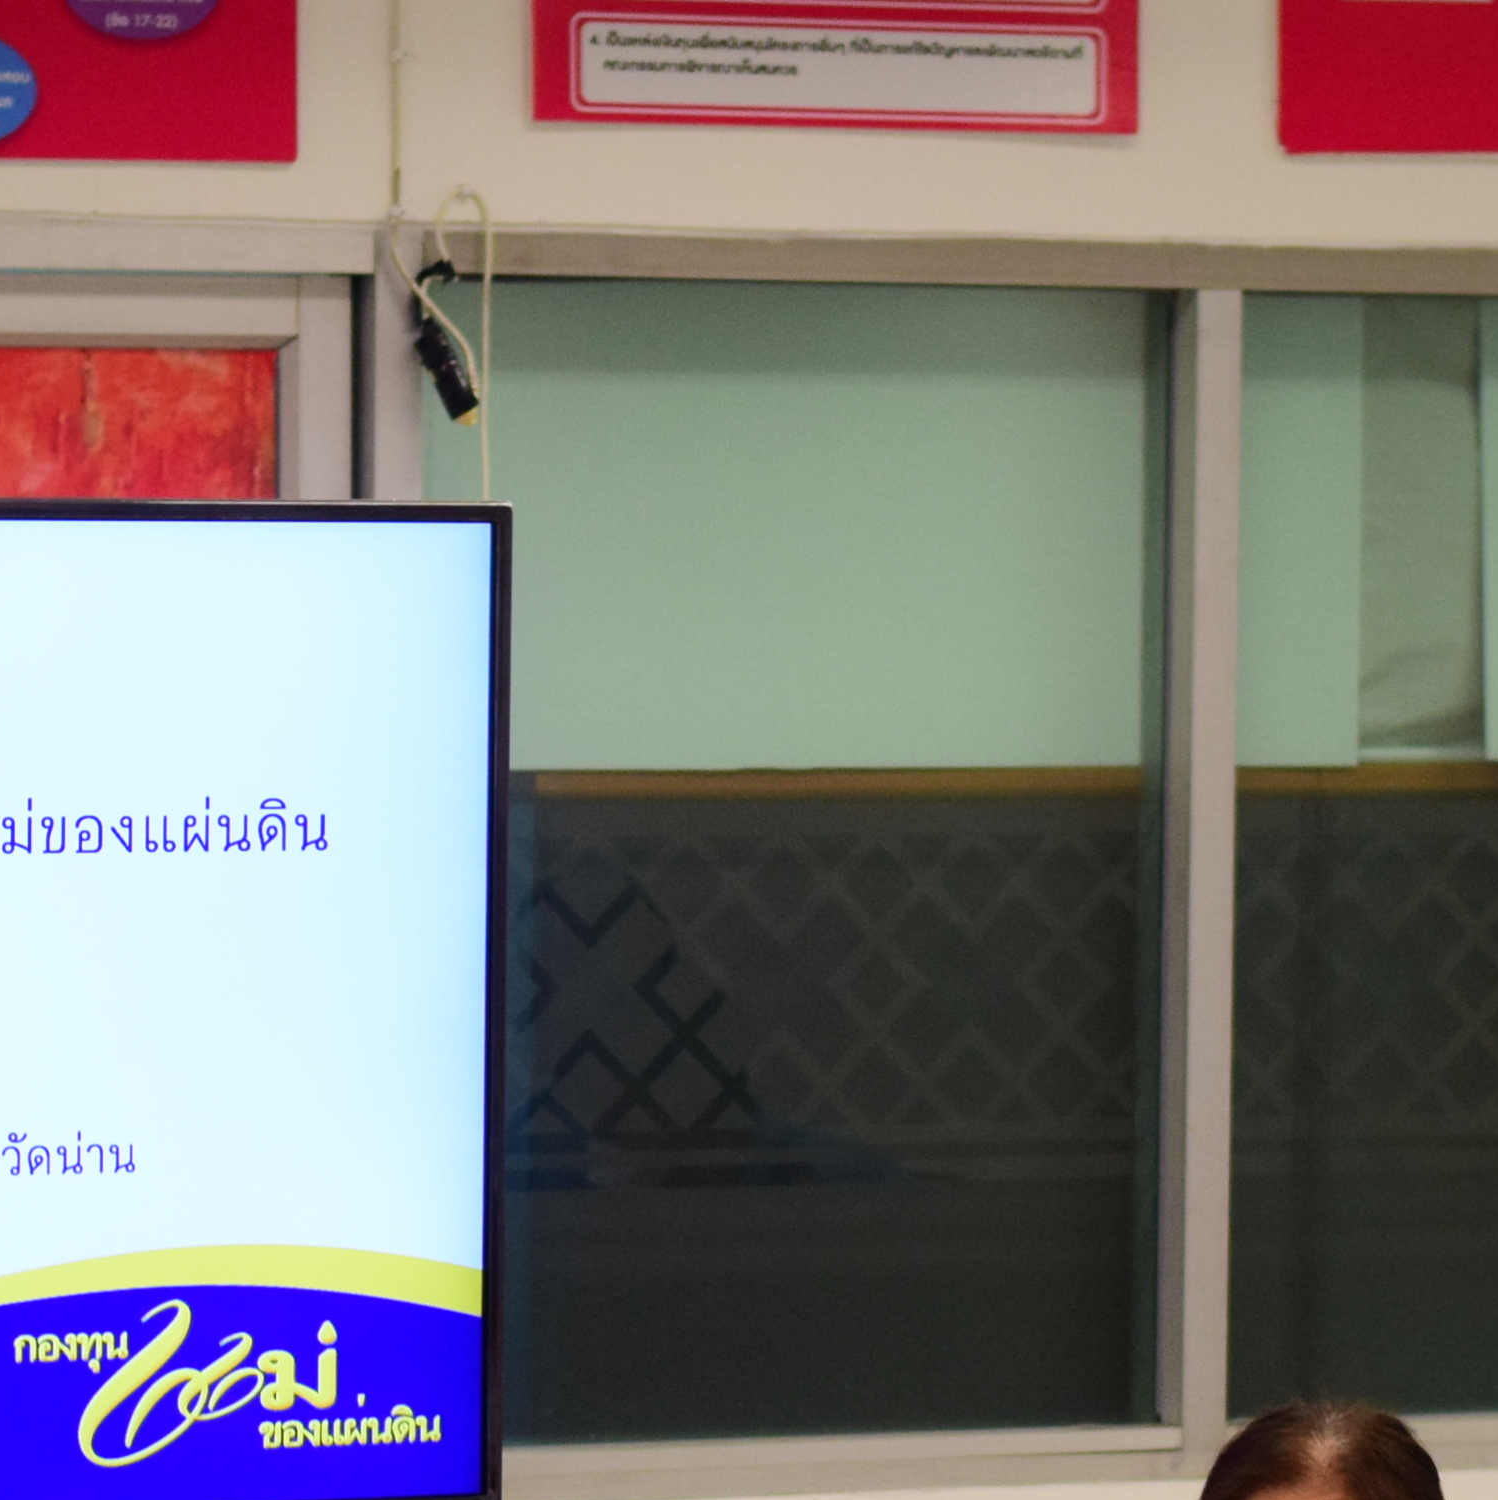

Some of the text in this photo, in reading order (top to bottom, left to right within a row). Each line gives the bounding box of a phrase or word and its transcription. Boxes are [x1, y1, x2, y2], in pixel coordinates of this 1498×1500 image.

[14, 1331, 129, 1374] กองทุน
[258, 1393, 442, 1449] ของแผ่นดิน
